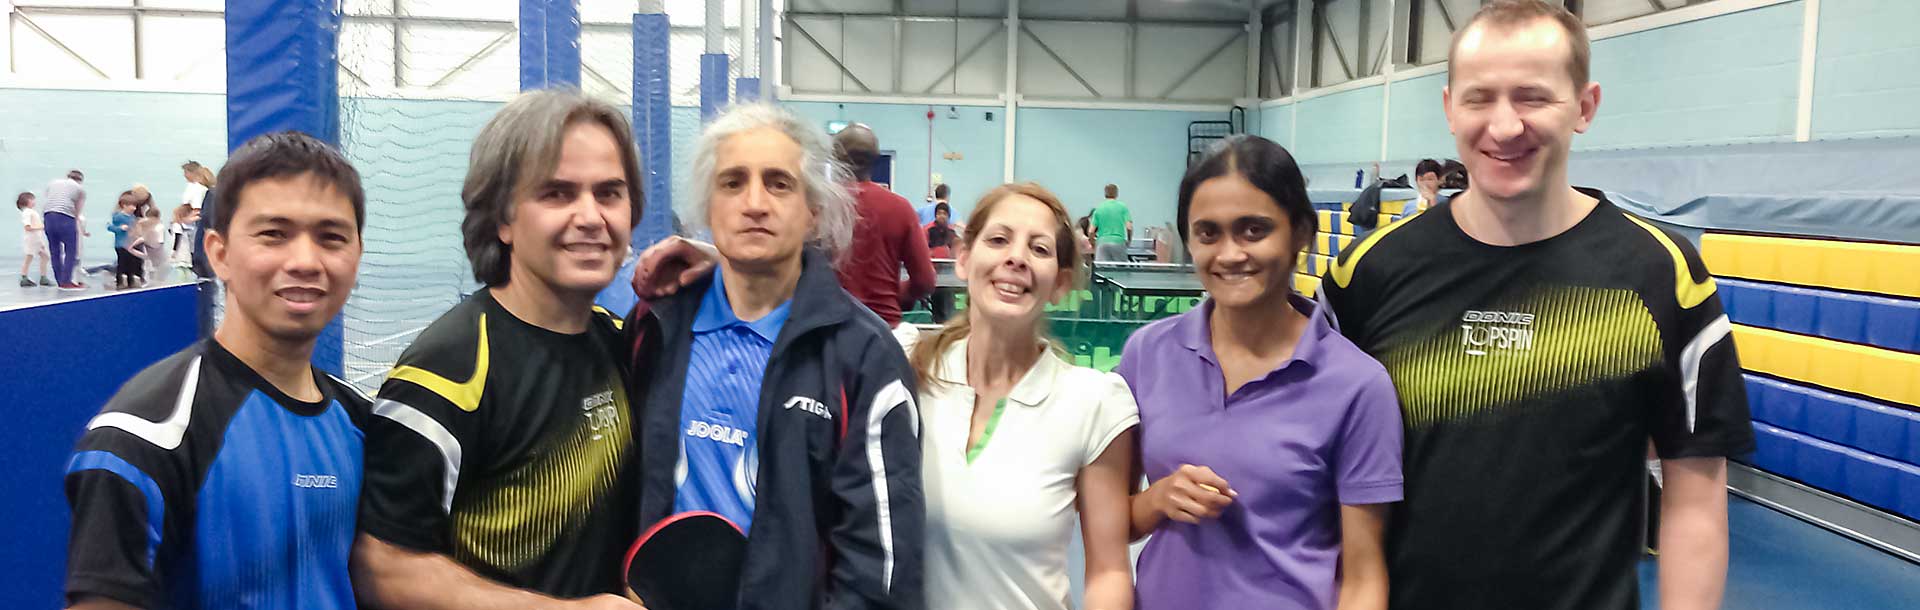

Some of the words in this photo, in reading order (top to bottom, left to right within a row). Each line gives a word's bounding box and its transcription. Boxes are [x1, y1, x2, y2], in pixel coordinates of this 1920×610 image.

[1462, 310, 1535, 325] DONIC
[1461, 325, 1534, 351] TOPSPIN
[687, 420, 744, 447] JOOLA
